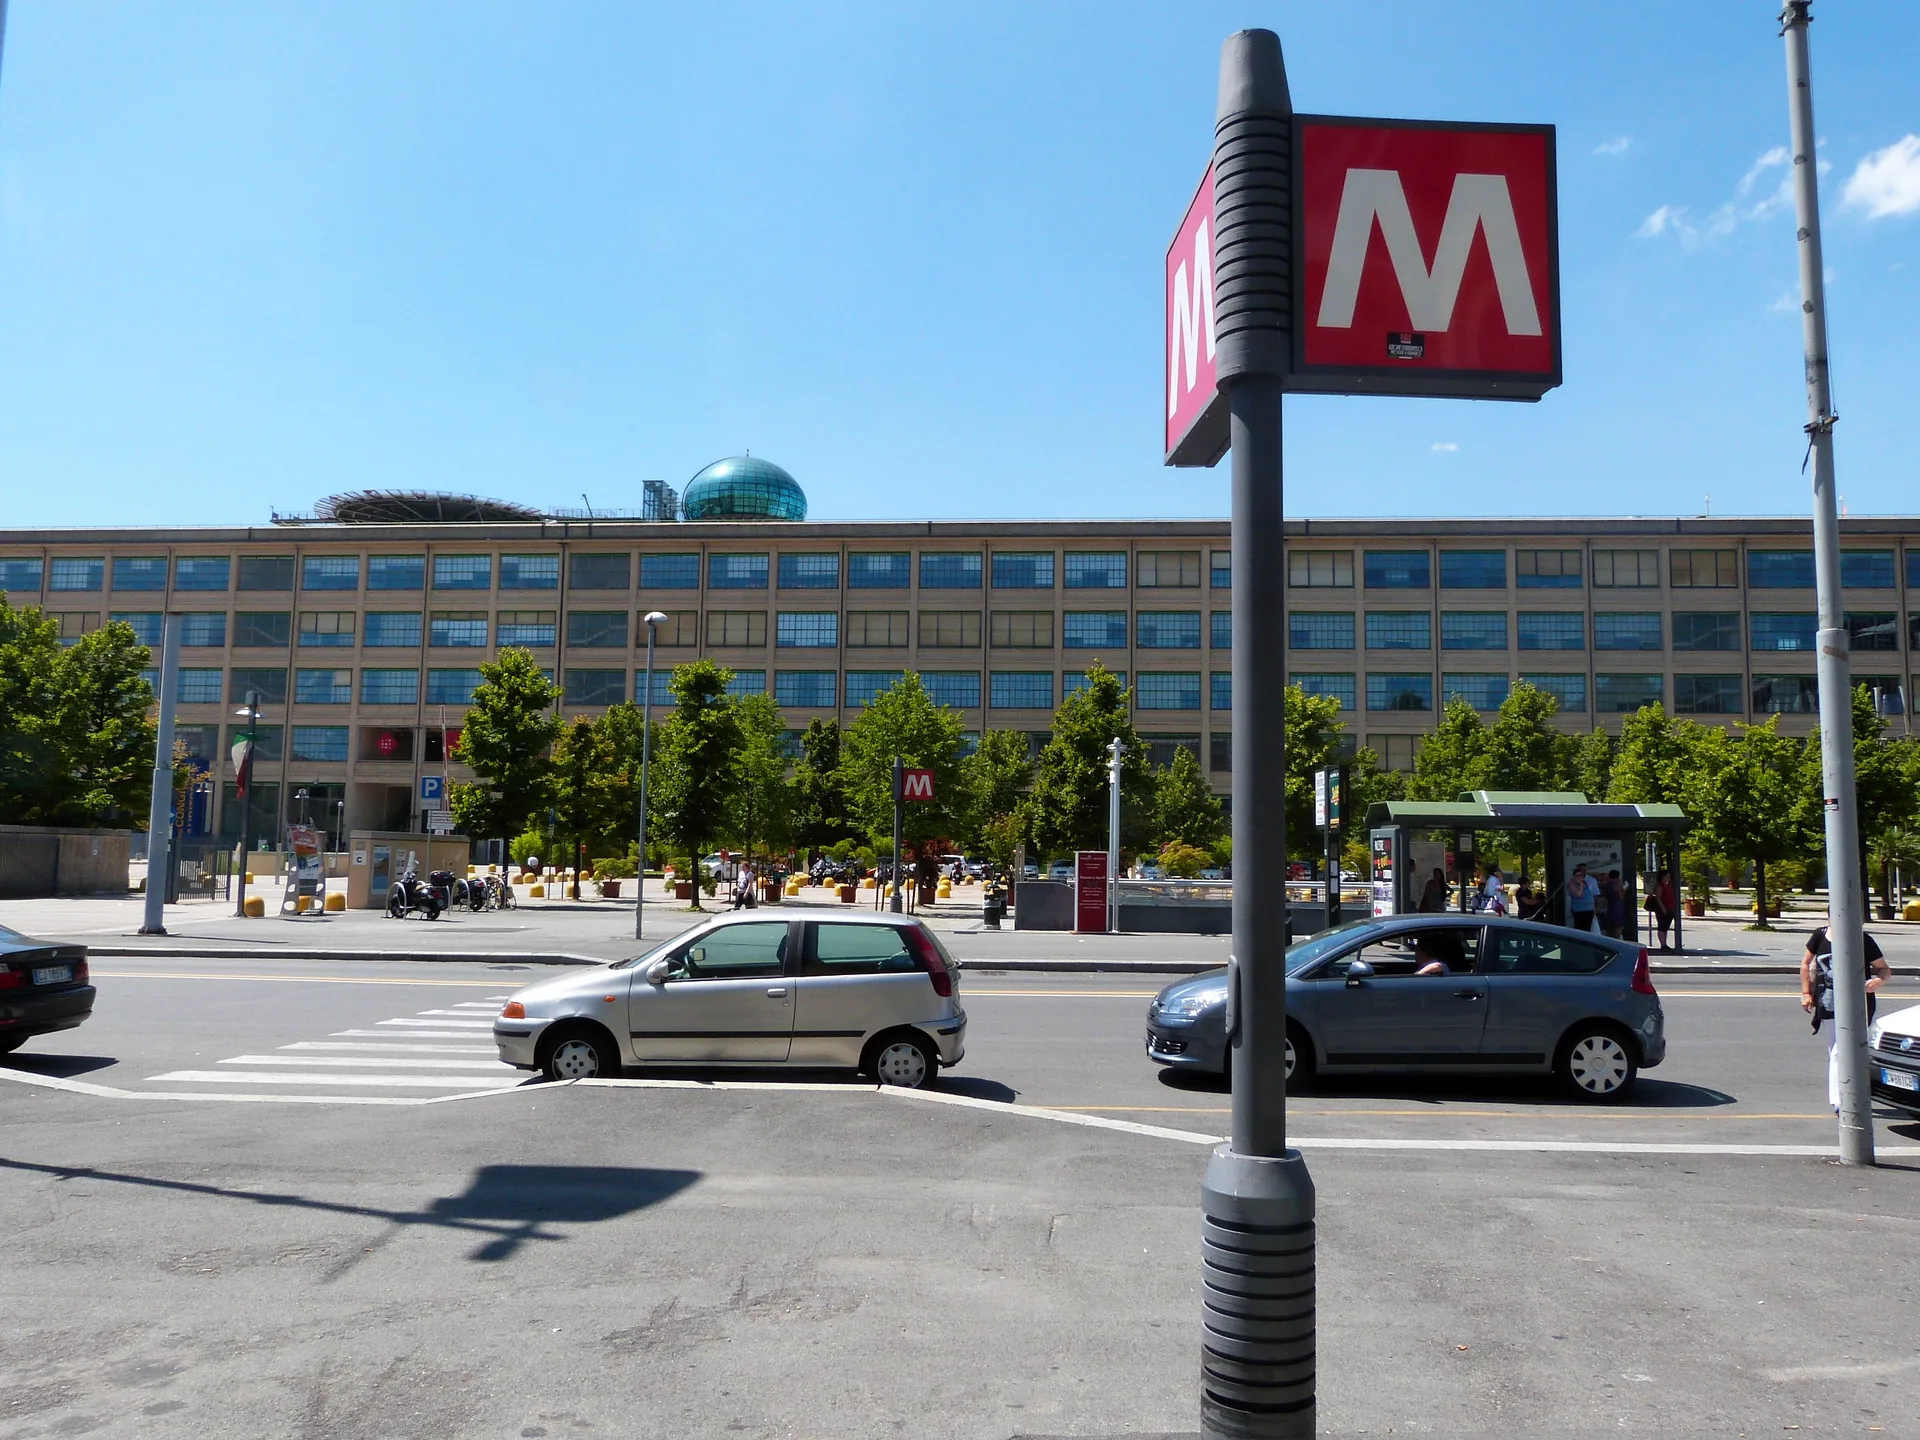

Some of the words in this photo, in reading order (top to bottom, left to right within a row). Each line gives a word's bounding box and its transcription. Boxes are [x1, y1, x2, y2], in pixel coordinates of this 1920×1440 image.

[1316, 168, 1542, 336] M
[1169, 215, 1216, 420] M
[425, 779, 438, 796] P
[904, 775, 932, 796] M
[1566, 847, 1601, 857] Pizzeria
[1571, 840, 1614, 849] Ristorante
